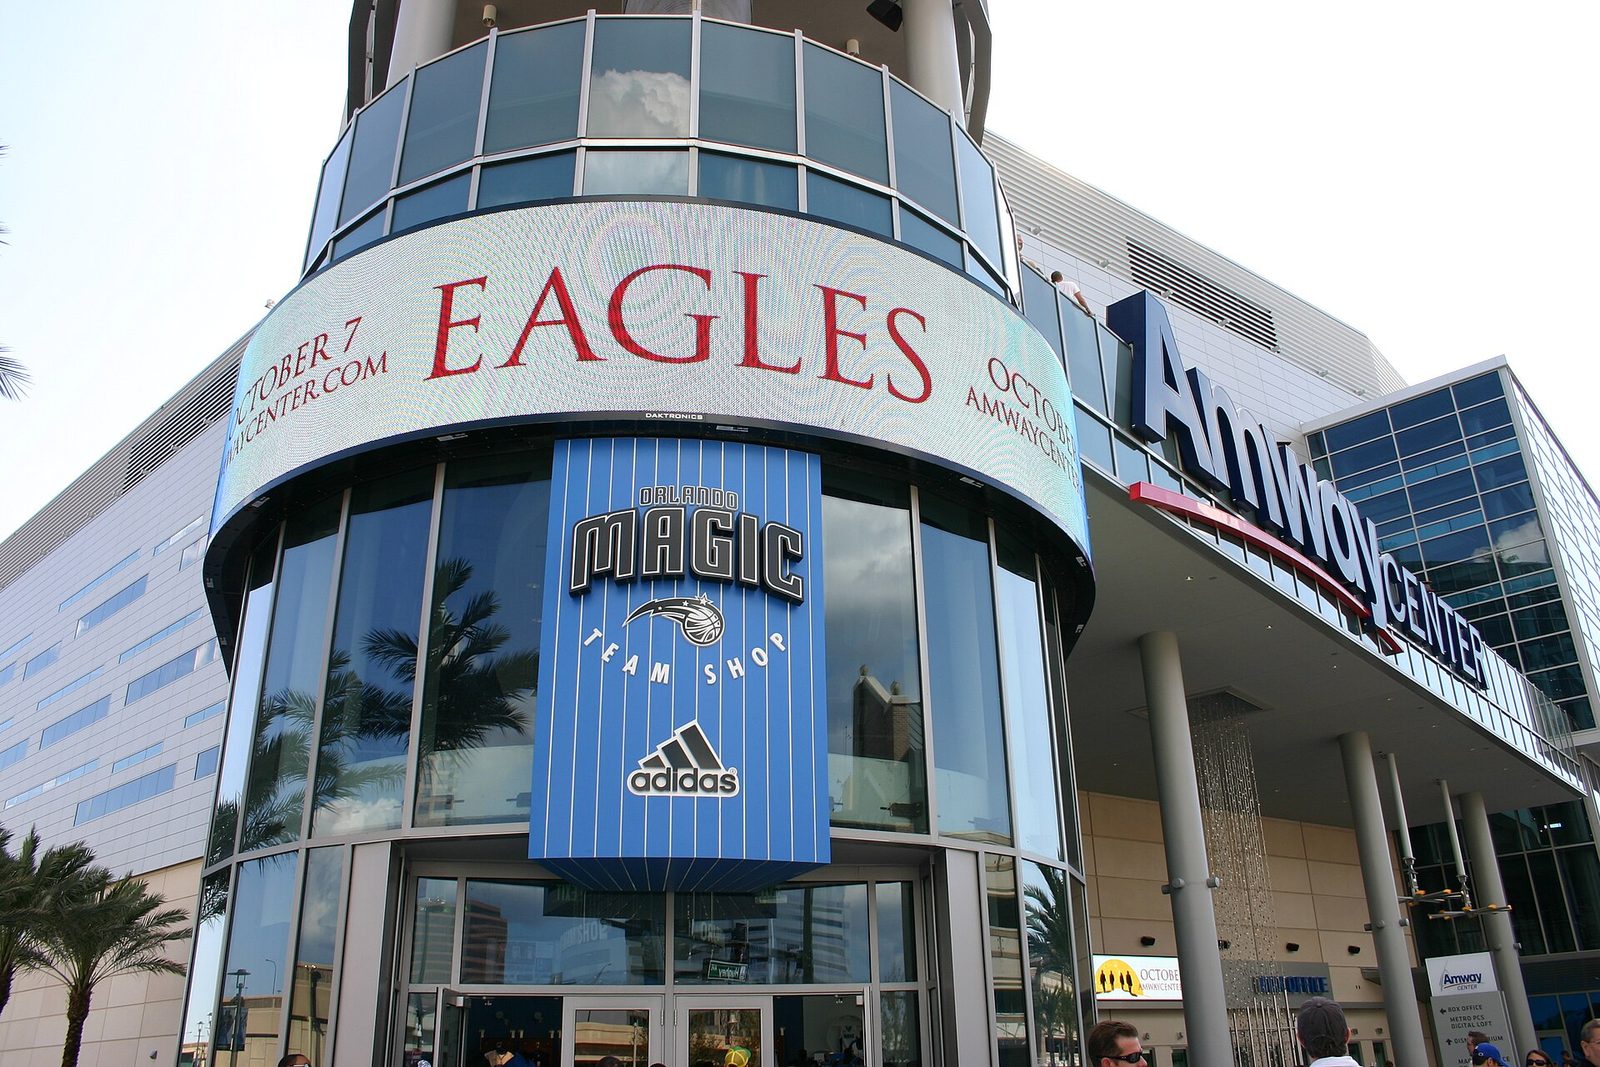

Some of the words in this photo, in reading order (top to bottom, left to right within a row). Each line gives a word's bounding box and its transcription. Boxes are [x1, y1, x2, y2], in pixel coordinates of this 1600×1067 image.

[343, 315, 363, 353] 7
[423, 264, 932, 404] EAGLES
[645, 411, 704, 421] DAKTRONICS
[638, 484, 739, 511] ORLANDO
[1110, 289, 1390, 631] Amway
[1381, 552, 1489, 689] CENTER
[569, 507, 804, 606] MAGIC
[583, 627, 670, 684] TEAM
[703, 631, 786, 685] SHOP
[630, 767, 738, 793] adidas
[1443, 973, 1482, 985] Amway
[1461, 1004, 1483, 1012] OFFICE
[1476, 1020, 1492, 1028] LOFT
